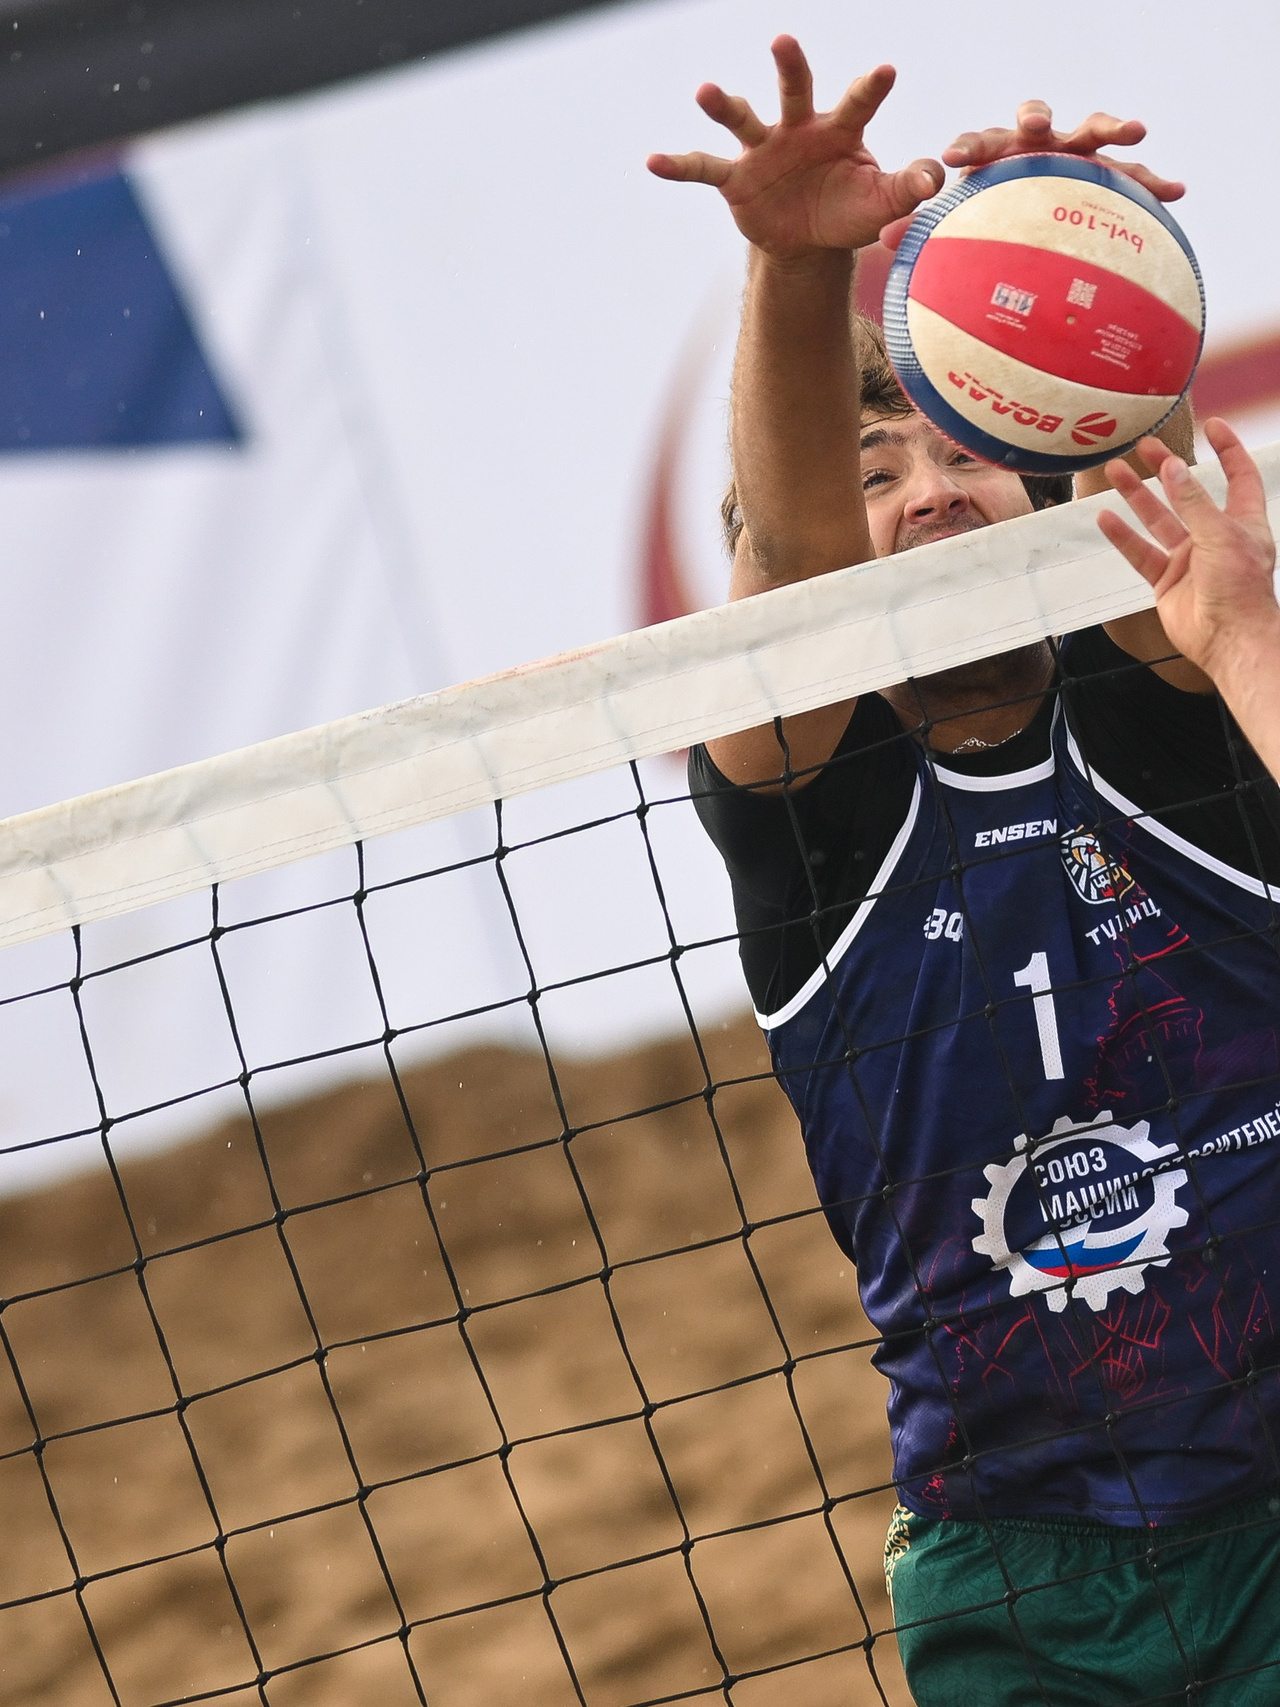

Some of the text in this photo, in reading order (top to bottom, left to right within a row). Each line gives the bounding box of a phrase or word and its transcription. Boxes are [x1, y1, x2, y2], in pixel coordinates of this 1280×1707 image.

[1053, 206, 1144, 254] bvl-100
[974, 818, 1058, 848] ENSEN
[1013, 952, 1065, 1080] 1
[1033, 1146, 1108, 1188] СОЮЗ
